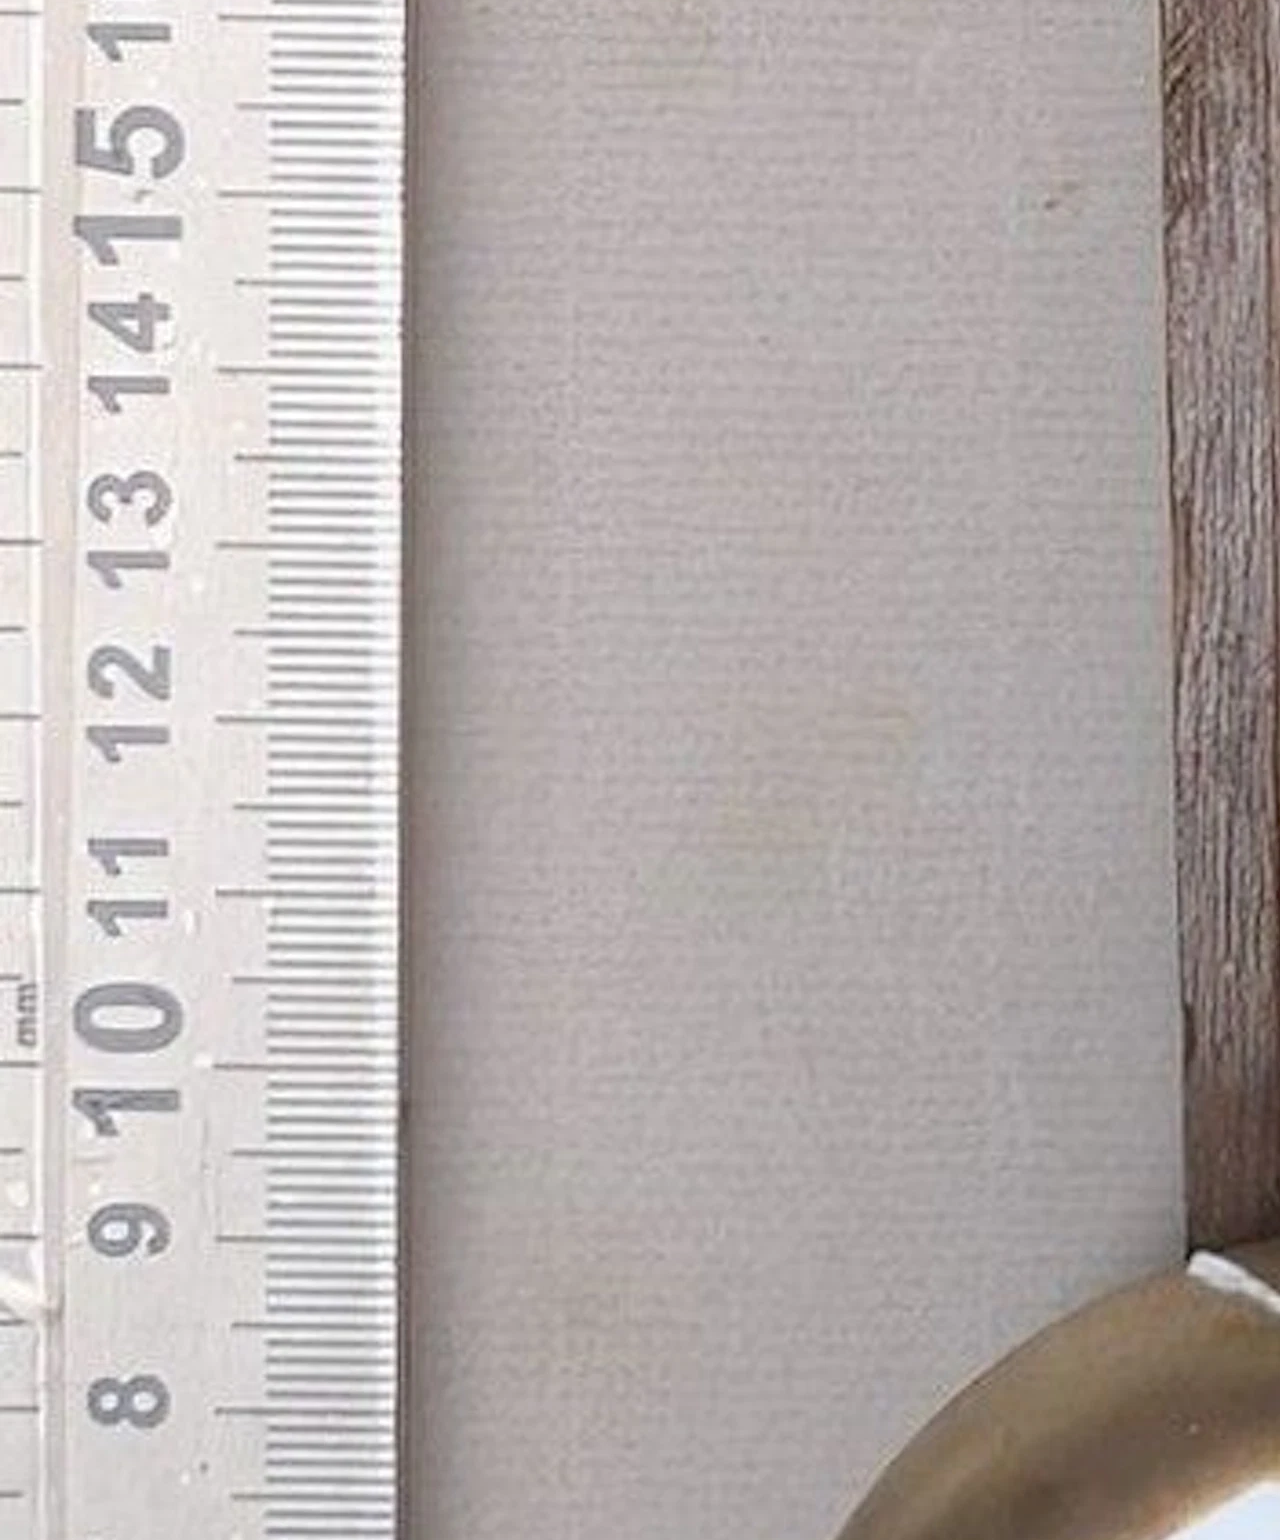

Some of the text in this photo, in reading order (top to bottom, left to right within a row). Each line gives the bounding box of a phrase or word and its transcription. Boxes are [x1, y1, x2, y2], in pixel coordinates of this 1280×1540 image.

[73, 106, 183, 264] 15
[87, 293, 170, 413] 14
[87, 471, 171, 589] 13
[87, 646, 170, 763] 12
[87, 838, 169, 937] 11
[73, 984, 182, 1136] 10
[88, 1204, 169, 1257] 9
[87, 1375, 170, 1428] 8
